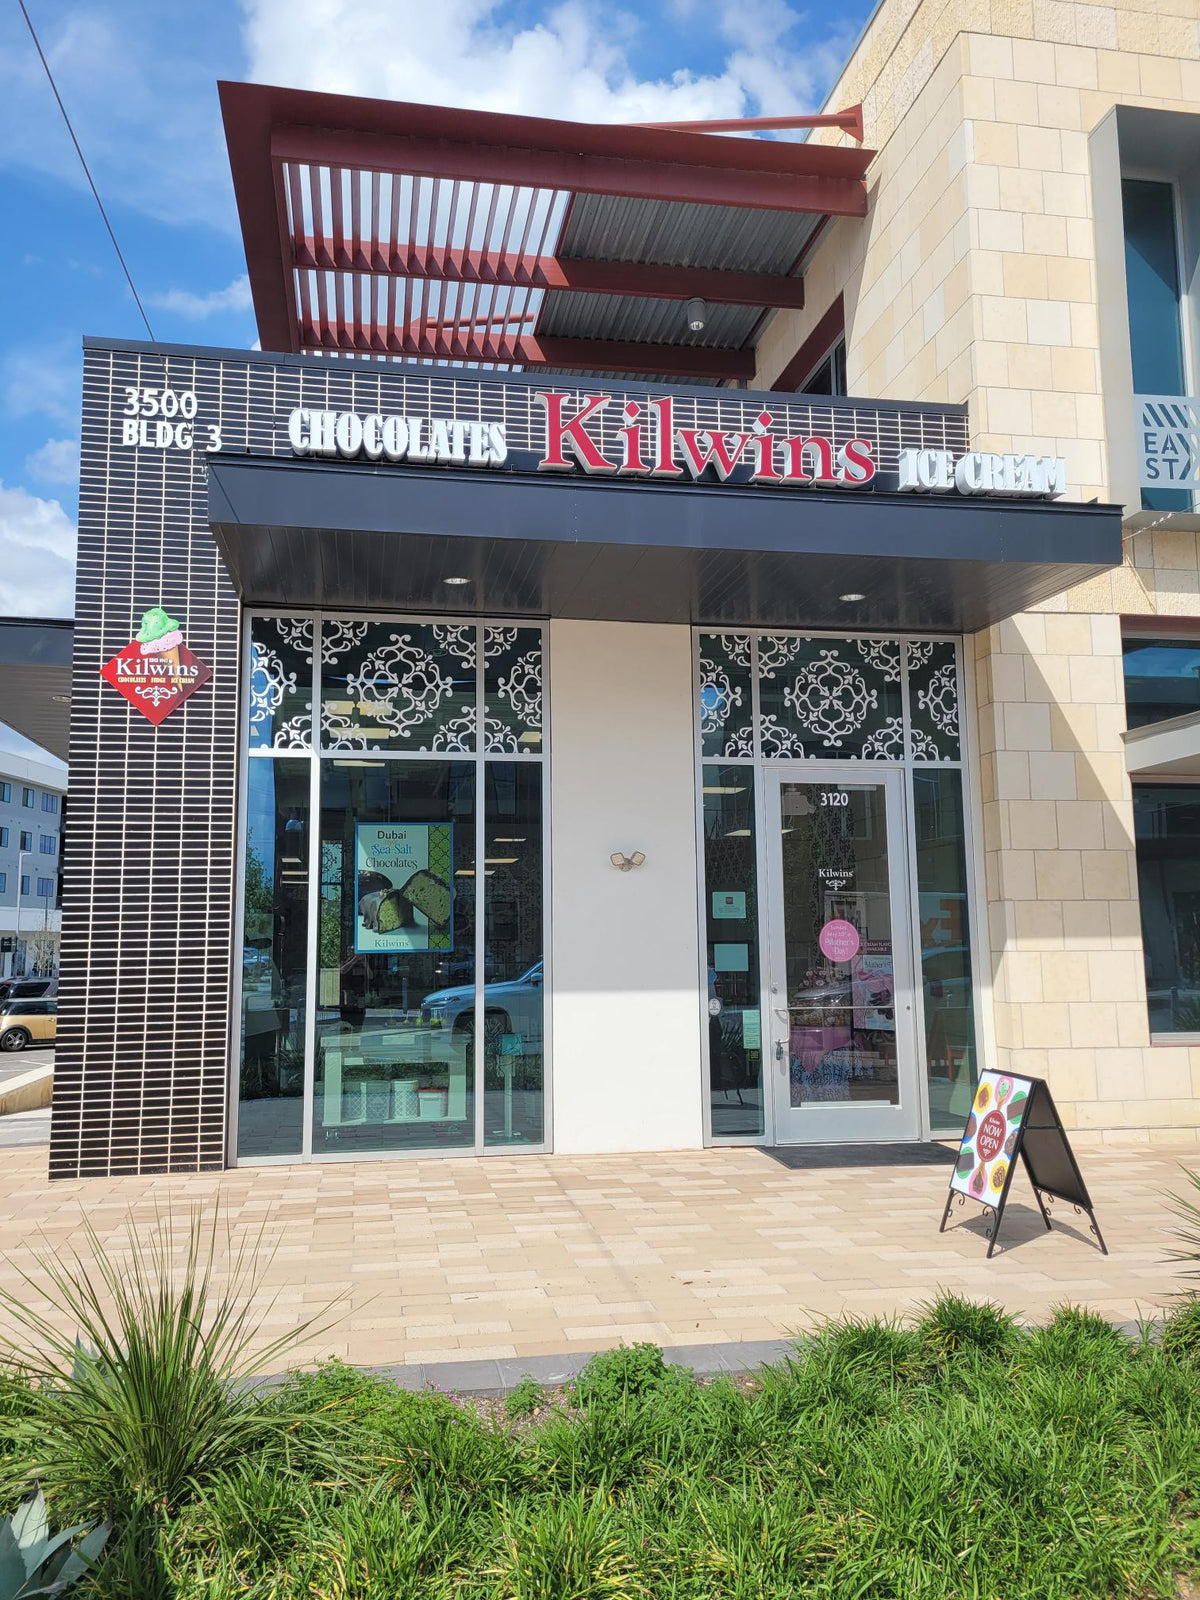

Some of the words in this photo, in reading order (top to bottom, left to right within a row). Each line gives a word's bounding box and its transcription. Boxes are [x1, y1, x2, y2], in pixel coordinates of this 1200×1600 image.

[123, 388, 198, 419] 3500
[122, 419, 194, 450] BLDG
[206, 425, 222, 452] 3
[288, 408, 508, 469] CHOCOLATES
[536, 391, 876, 487] Kilwins
[897, 448, 955, 493] ICE
[956, 452, 1066, 500] CREAM
[116, 658, 199, 677] Kilwins
[820, 792, 849, 807] 3120
[377, 830, 407, 840] Dubai
[371, 844, 392, 856] Sea
[395, 843, 412, 855] Salt
[365, 857, 418, 870] Chocolates
[818, 868, 854, 878] Kilwins
[374, 939, 409, 948] Kilwins
[983, 1123, 1002, 1136] NOW
[980, 1135, 999, 1150] OPEN
